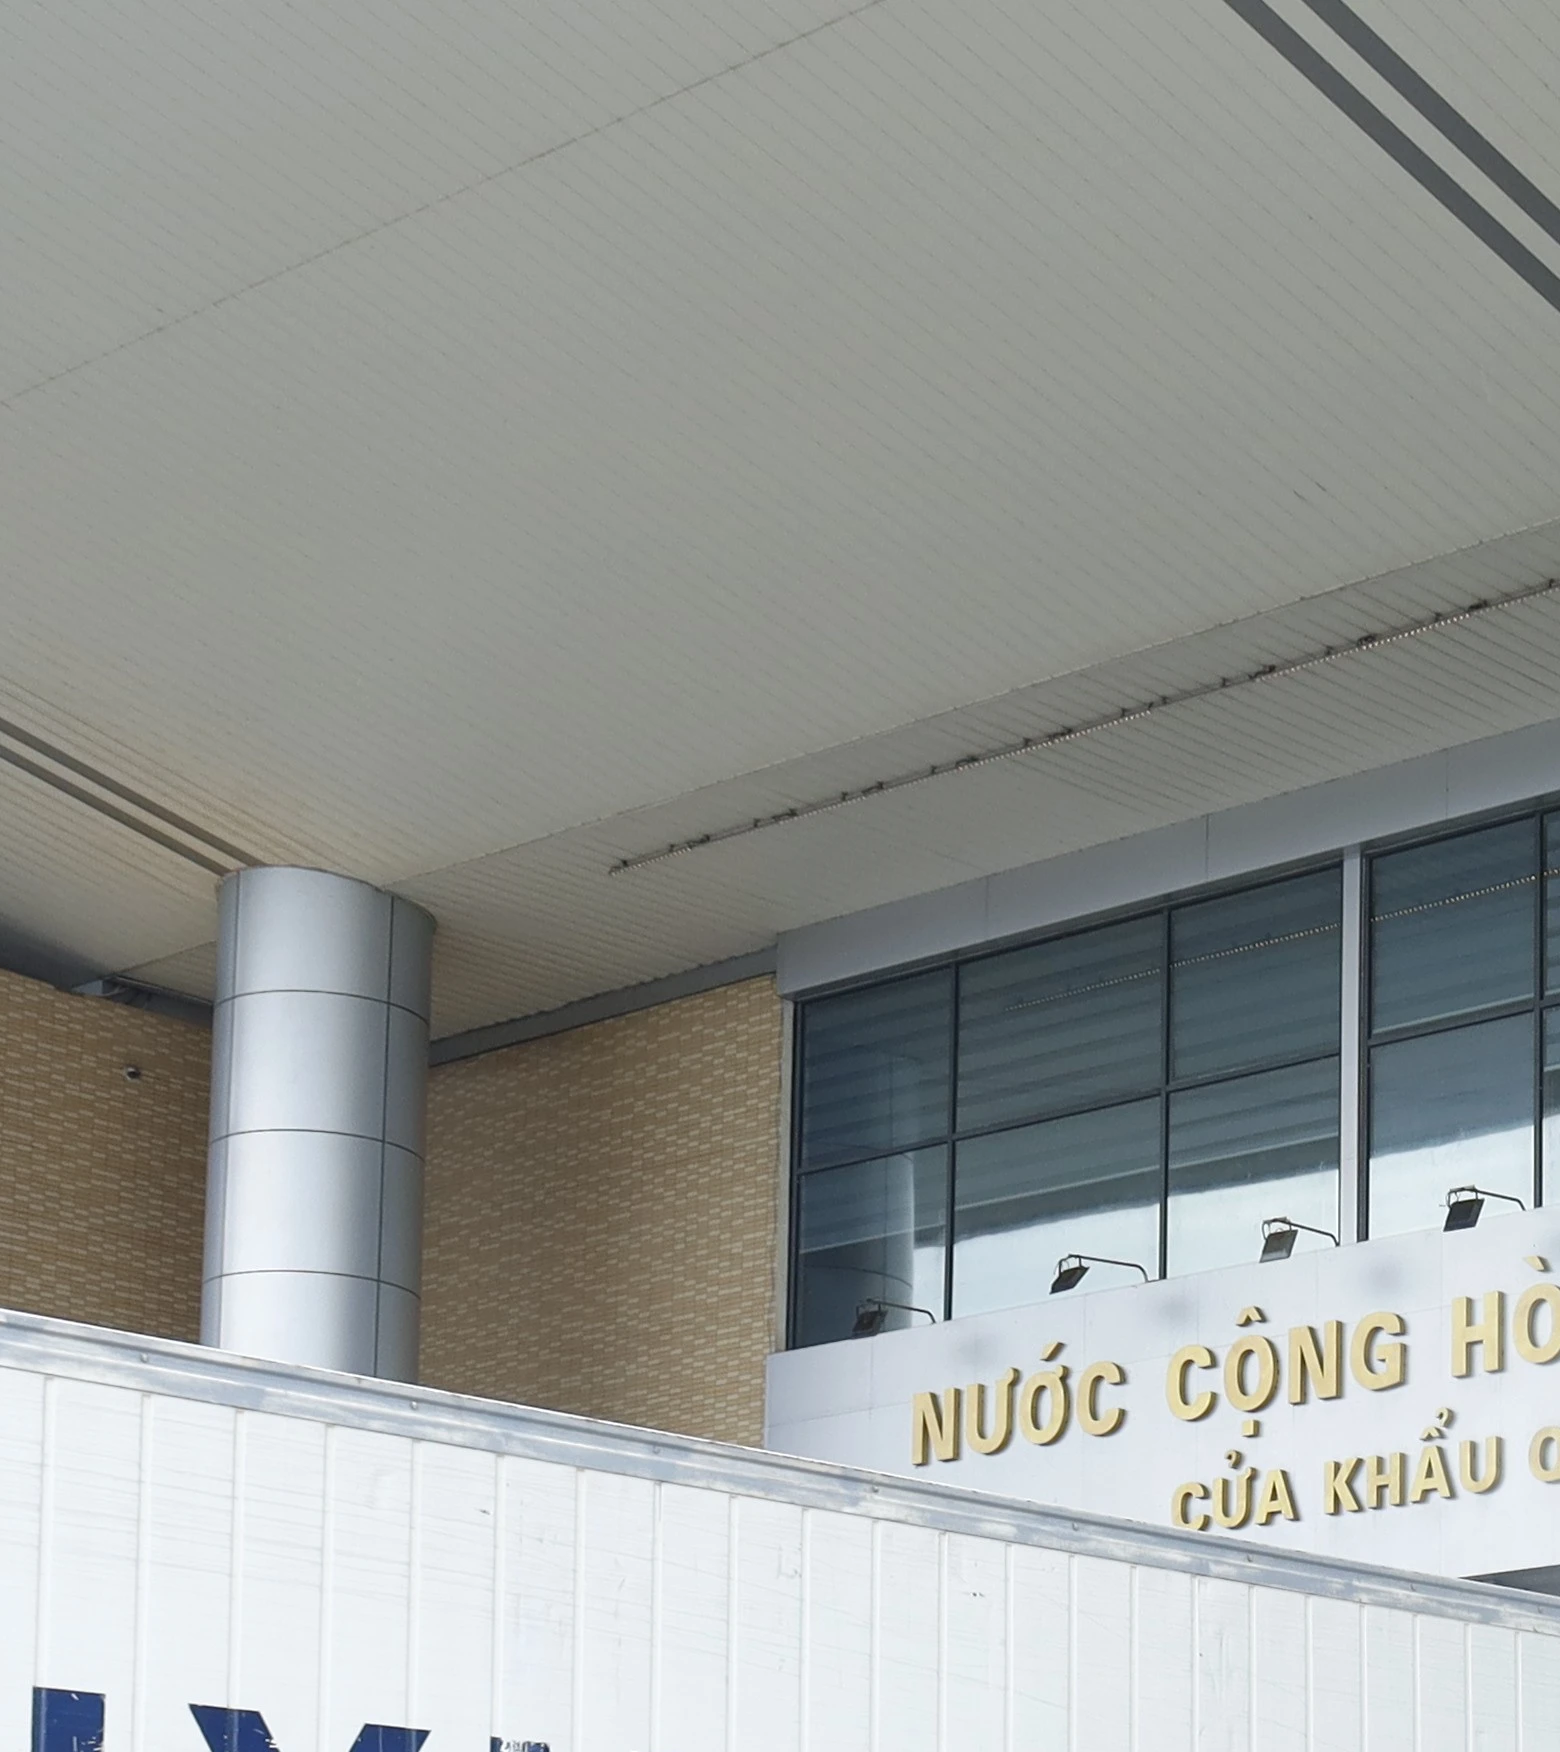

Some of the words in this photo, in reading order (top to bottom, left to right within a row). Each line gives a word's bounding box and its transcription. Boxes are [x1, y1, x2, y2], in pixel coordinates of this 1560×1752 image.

[910, 1342, 1128, 1466] NƯỚC
[1166, 1307, 1406, 1437] CỘNG
[1171, 1448, 1297, 1532] CỬA
[1324, 1407, 1504, 1516] KHẨU
